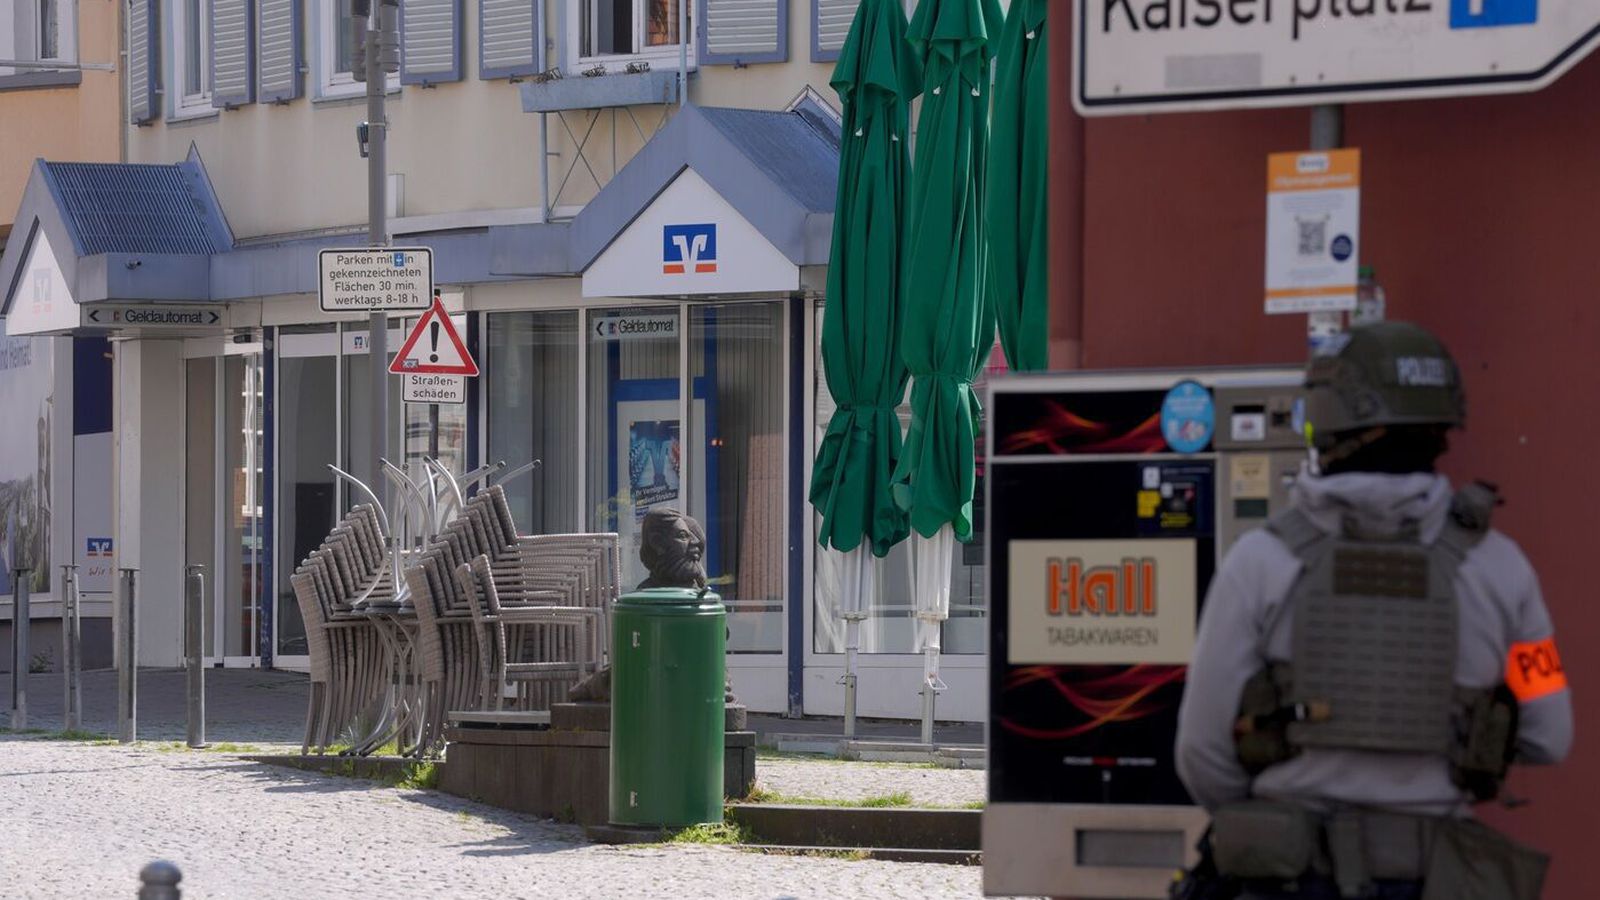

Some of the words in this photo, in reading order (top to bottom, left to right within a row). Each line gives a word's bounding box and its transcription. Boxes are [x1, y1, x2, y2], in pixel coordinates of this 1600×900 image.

[336, 255, 374, 265] Parken
[376, 255, 393, 265] mit
[404, 254, 414, 264] in
[329, 268, 422, 281] gekennzeichneten
[334, 281, 376, 292] Flächen
[379, 281, 391, 291] 30
[395, 281, 417, 291] min.
[335, 295, 382, 306] werktags
[386, 294, 408, 304] 8-18
[412, 294, 419, 304] h
[125, 309, 203, 324] Geldautomat
[618, 318, 674, 334] Geldautomat
[411, 375, 458, 386] Straßen-
[412, 388, 457, 399] schäden
[1046, 557, 1157, 617] Hall
[1046, 627, 1158, 646] TABAKWAREN
